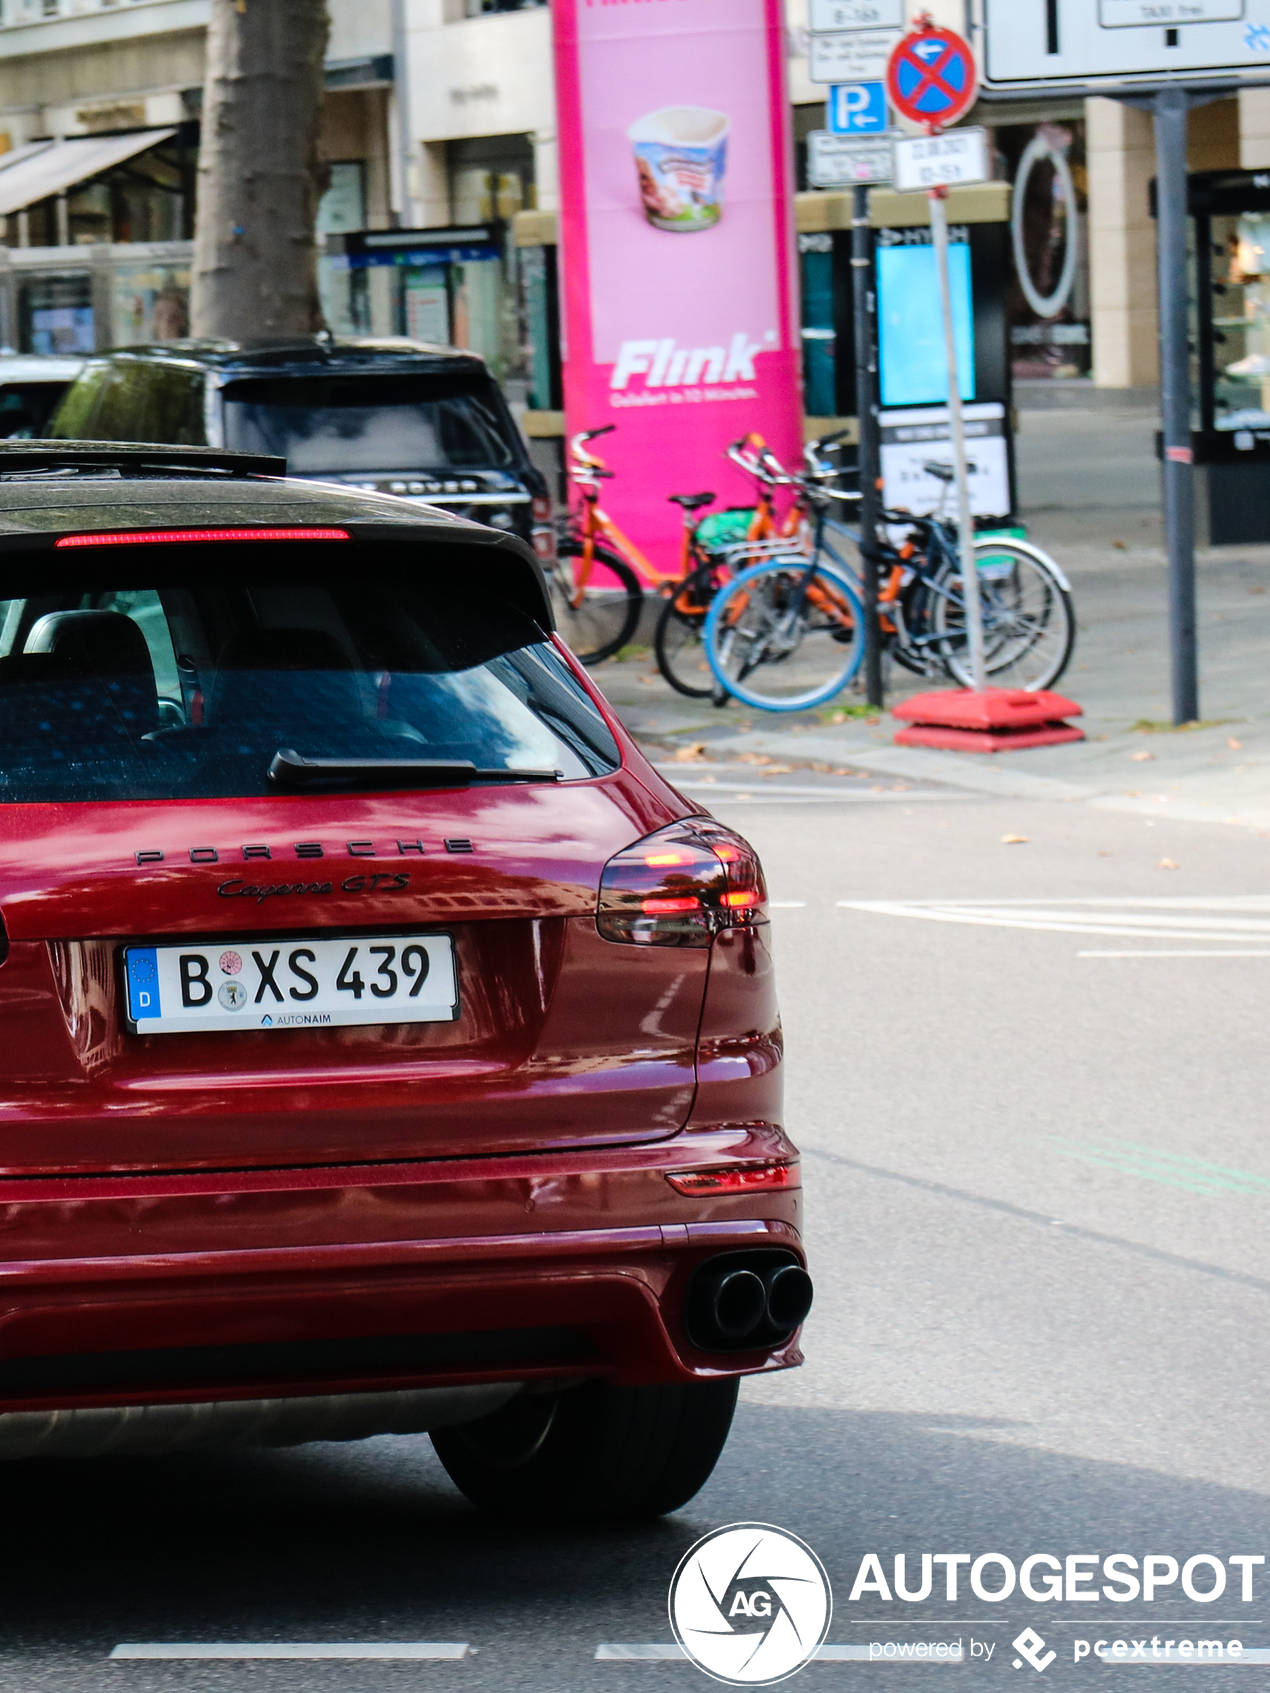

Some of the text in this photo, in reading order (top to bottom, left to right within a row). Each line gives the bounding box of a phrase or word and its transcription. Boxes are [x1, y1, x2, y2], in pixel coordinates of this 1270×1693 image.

[610, 331, 762, 390] Flink
[134, 838, 475, 866] PORSCHE
[216, 872, 411, 904] Cayenne GTS
[179, 954, 213, 1008] B
[251, 948, 320, 1004] XS
[335, 944, 431, 1000] 439
[139, 991, 151, 1008] D
[276, 1013, 332, 1026] AUTONAIM
